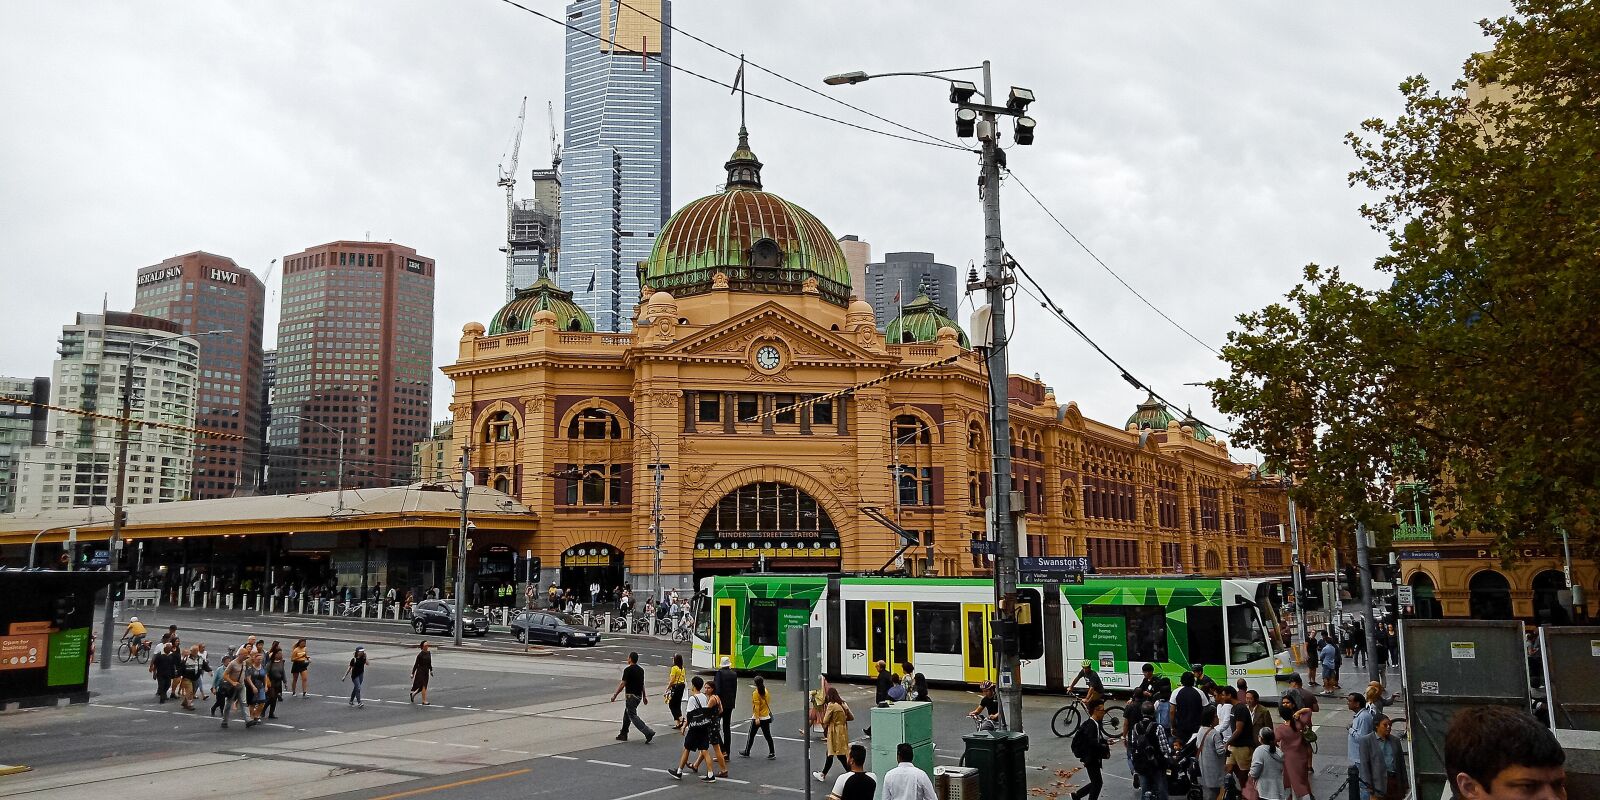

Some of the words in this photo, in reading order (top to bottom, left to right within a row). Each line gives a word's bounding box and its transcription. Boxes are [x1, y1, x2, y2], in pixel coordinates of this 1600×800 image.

[409, 261, 420, 269] IBM
[166, 265, 181, 278] SUN
[211, 268, 239, 284] HWT
[1038, 557, 1077, 566] Swanston
[1078, 557, 1088, 566] St
